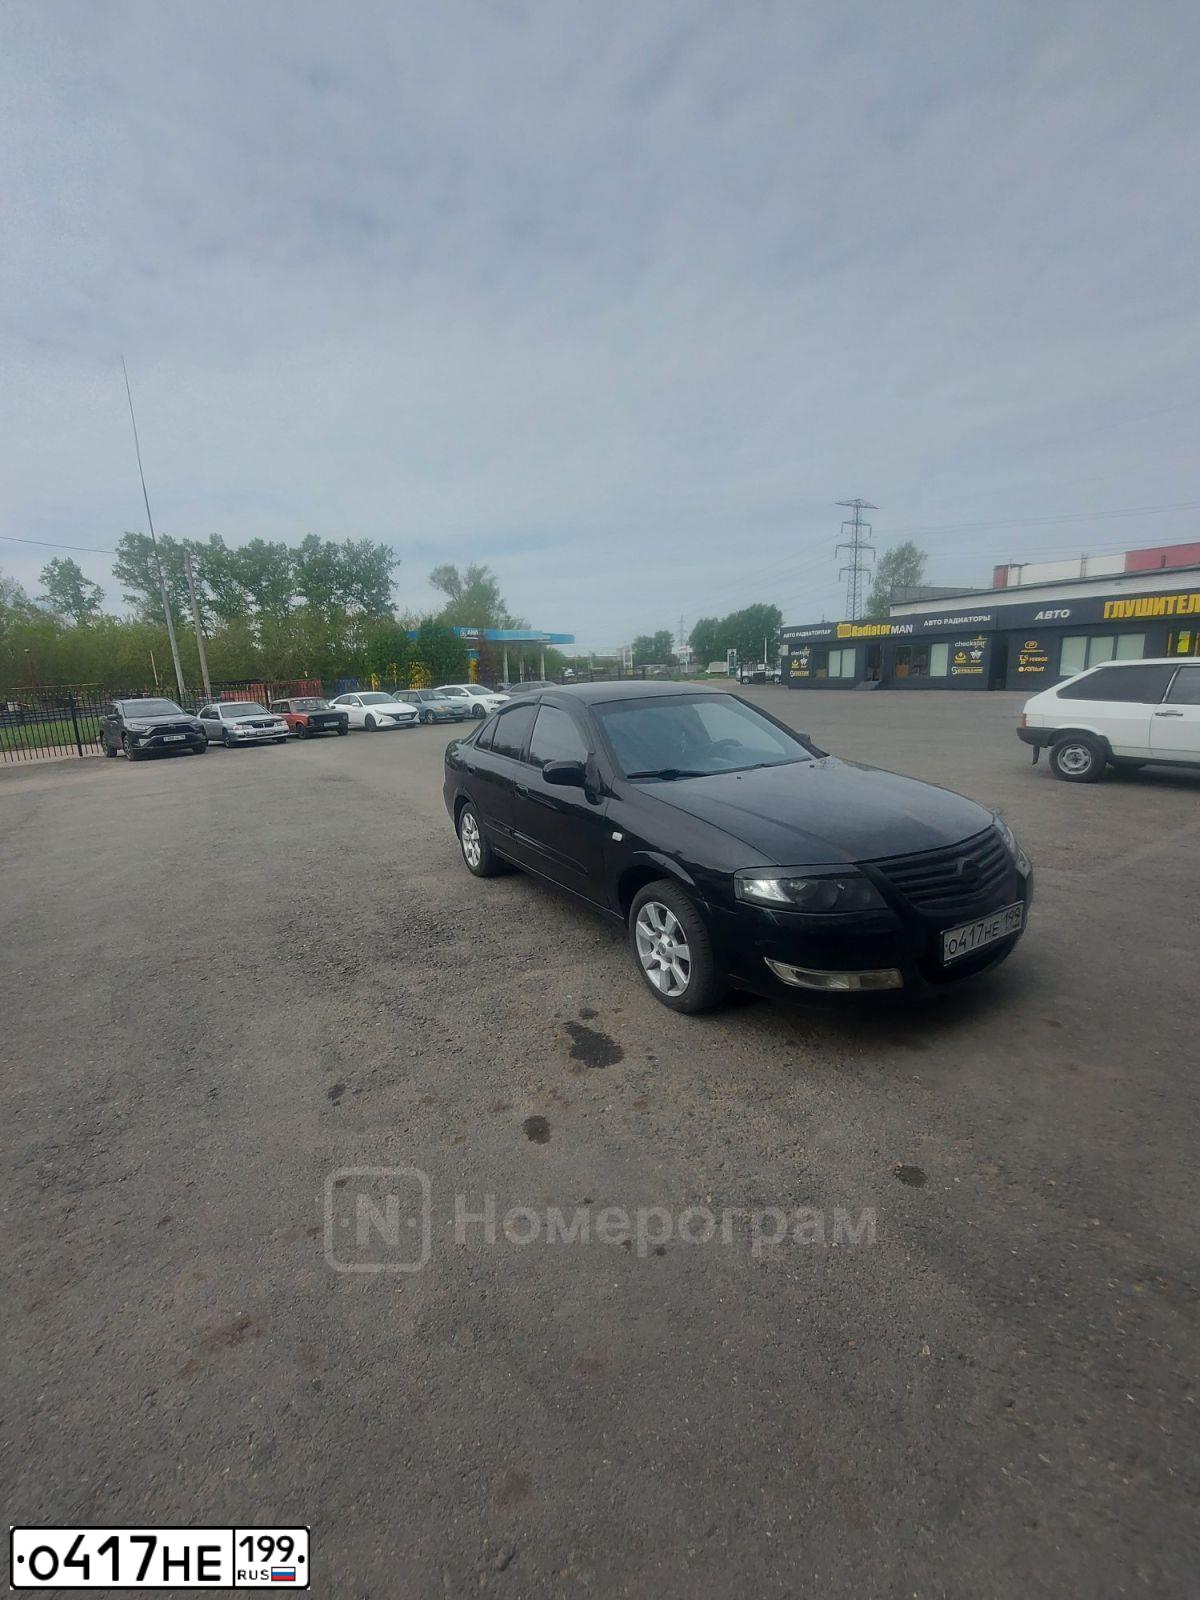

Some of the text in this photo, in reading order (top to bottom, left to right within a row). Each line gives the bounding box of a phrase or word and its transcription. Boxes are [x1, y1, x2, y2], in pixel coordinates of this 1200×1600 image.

[924, 614, 991, 627] АВТО РАДИАТОРЫ
[1034, 608, 1070, 621] АВТО
